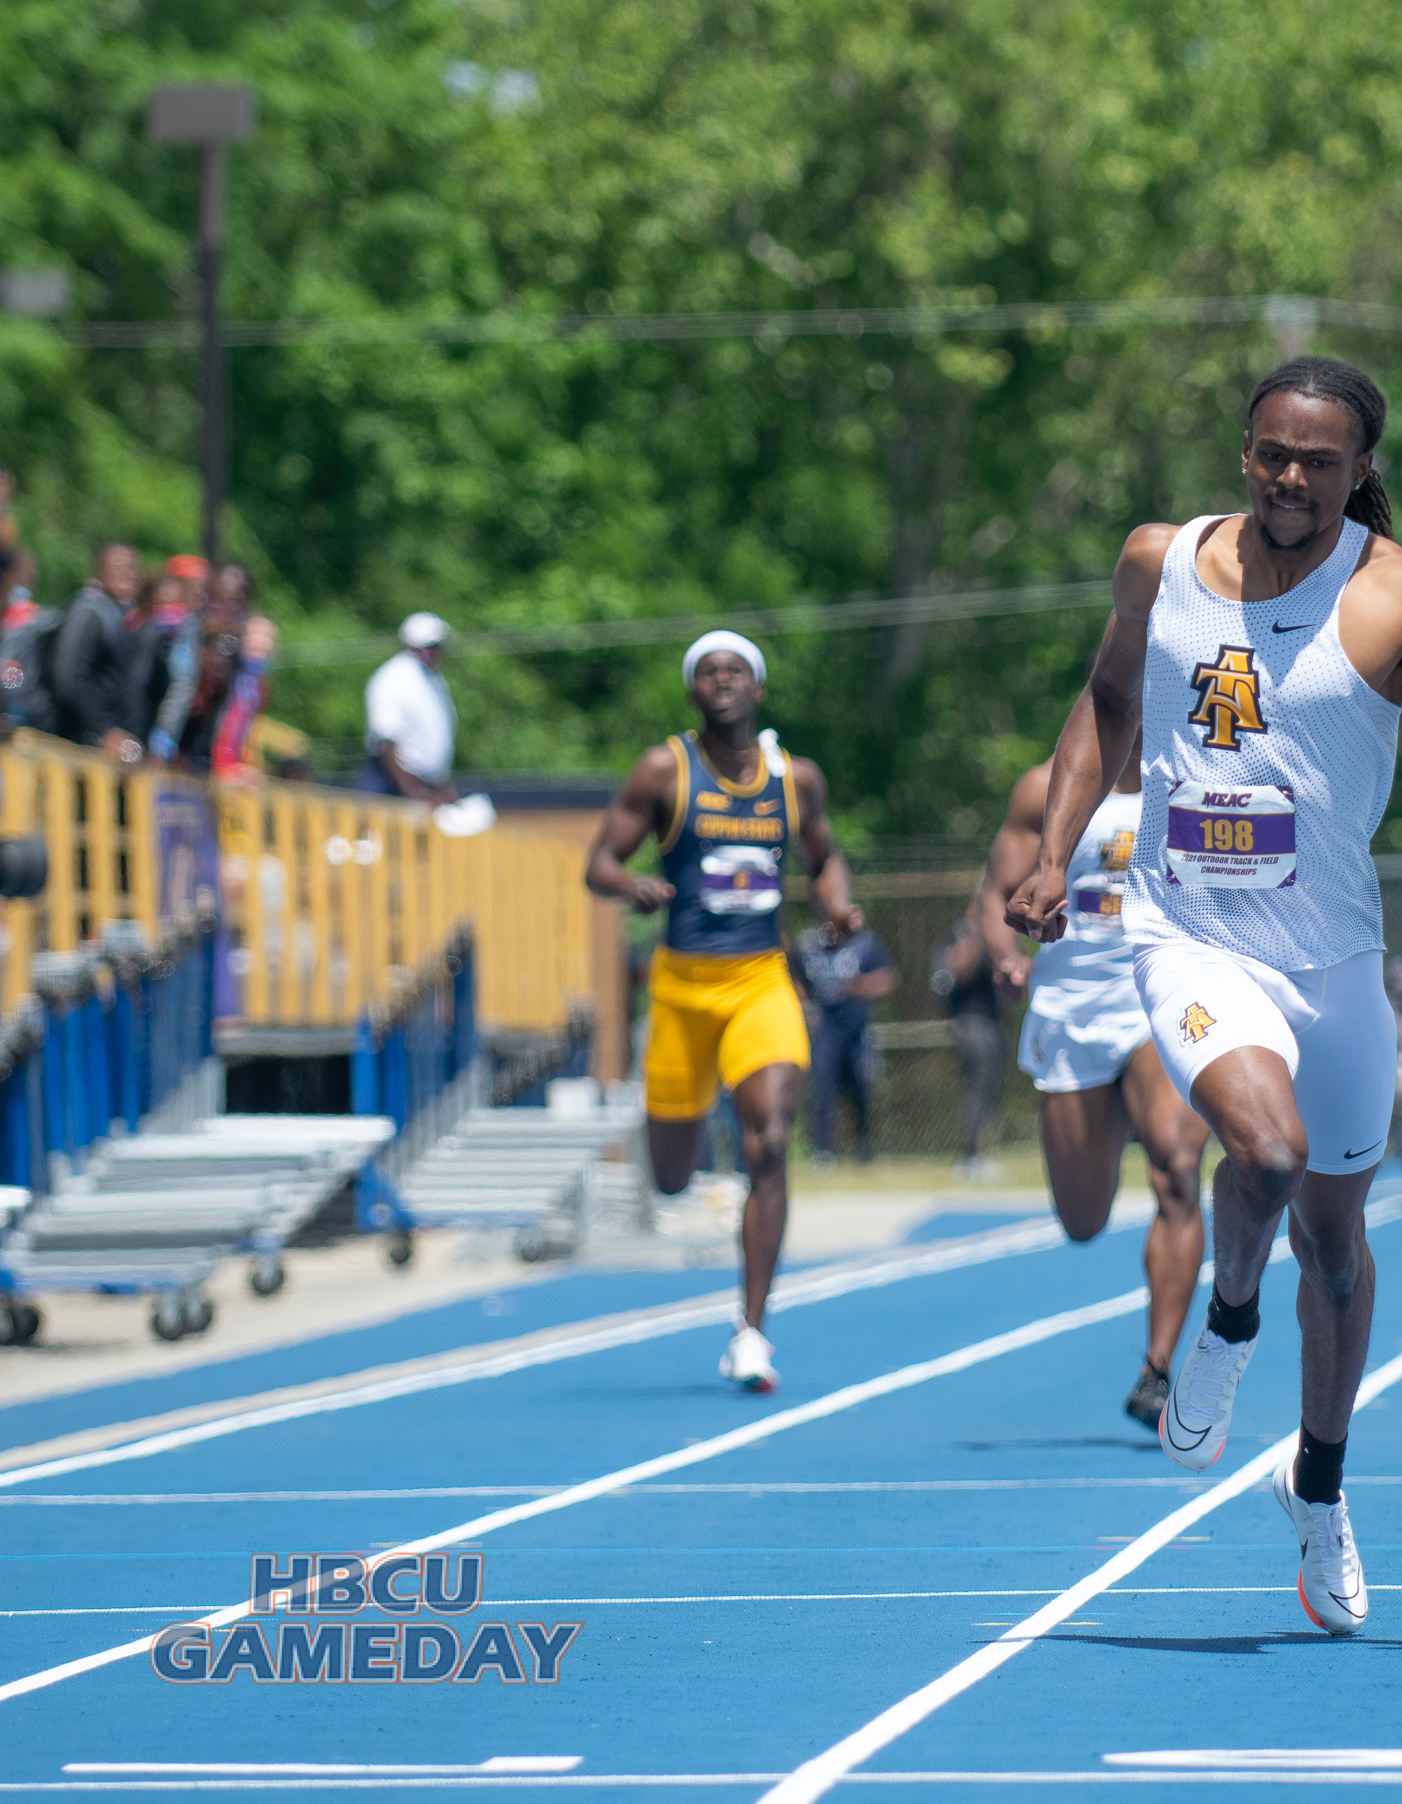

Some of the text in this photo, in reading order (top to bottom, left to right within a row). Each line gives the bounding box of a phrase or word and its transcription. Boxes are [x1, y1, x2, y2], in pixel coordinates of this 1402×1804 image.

[1201, 791, 1253, 808] MEAC
[1199, 818, 1254, 851] 198
[1181, 854, 1197, 862] 2021
[1197, 854, 1229, 864] OUTDOOR
[1229, 857, 1254, 866] TRACK
[1259, 856, 1280, 865] FIELD
[1200, 865, 1258, 876] CHAMPIONSHIPS
